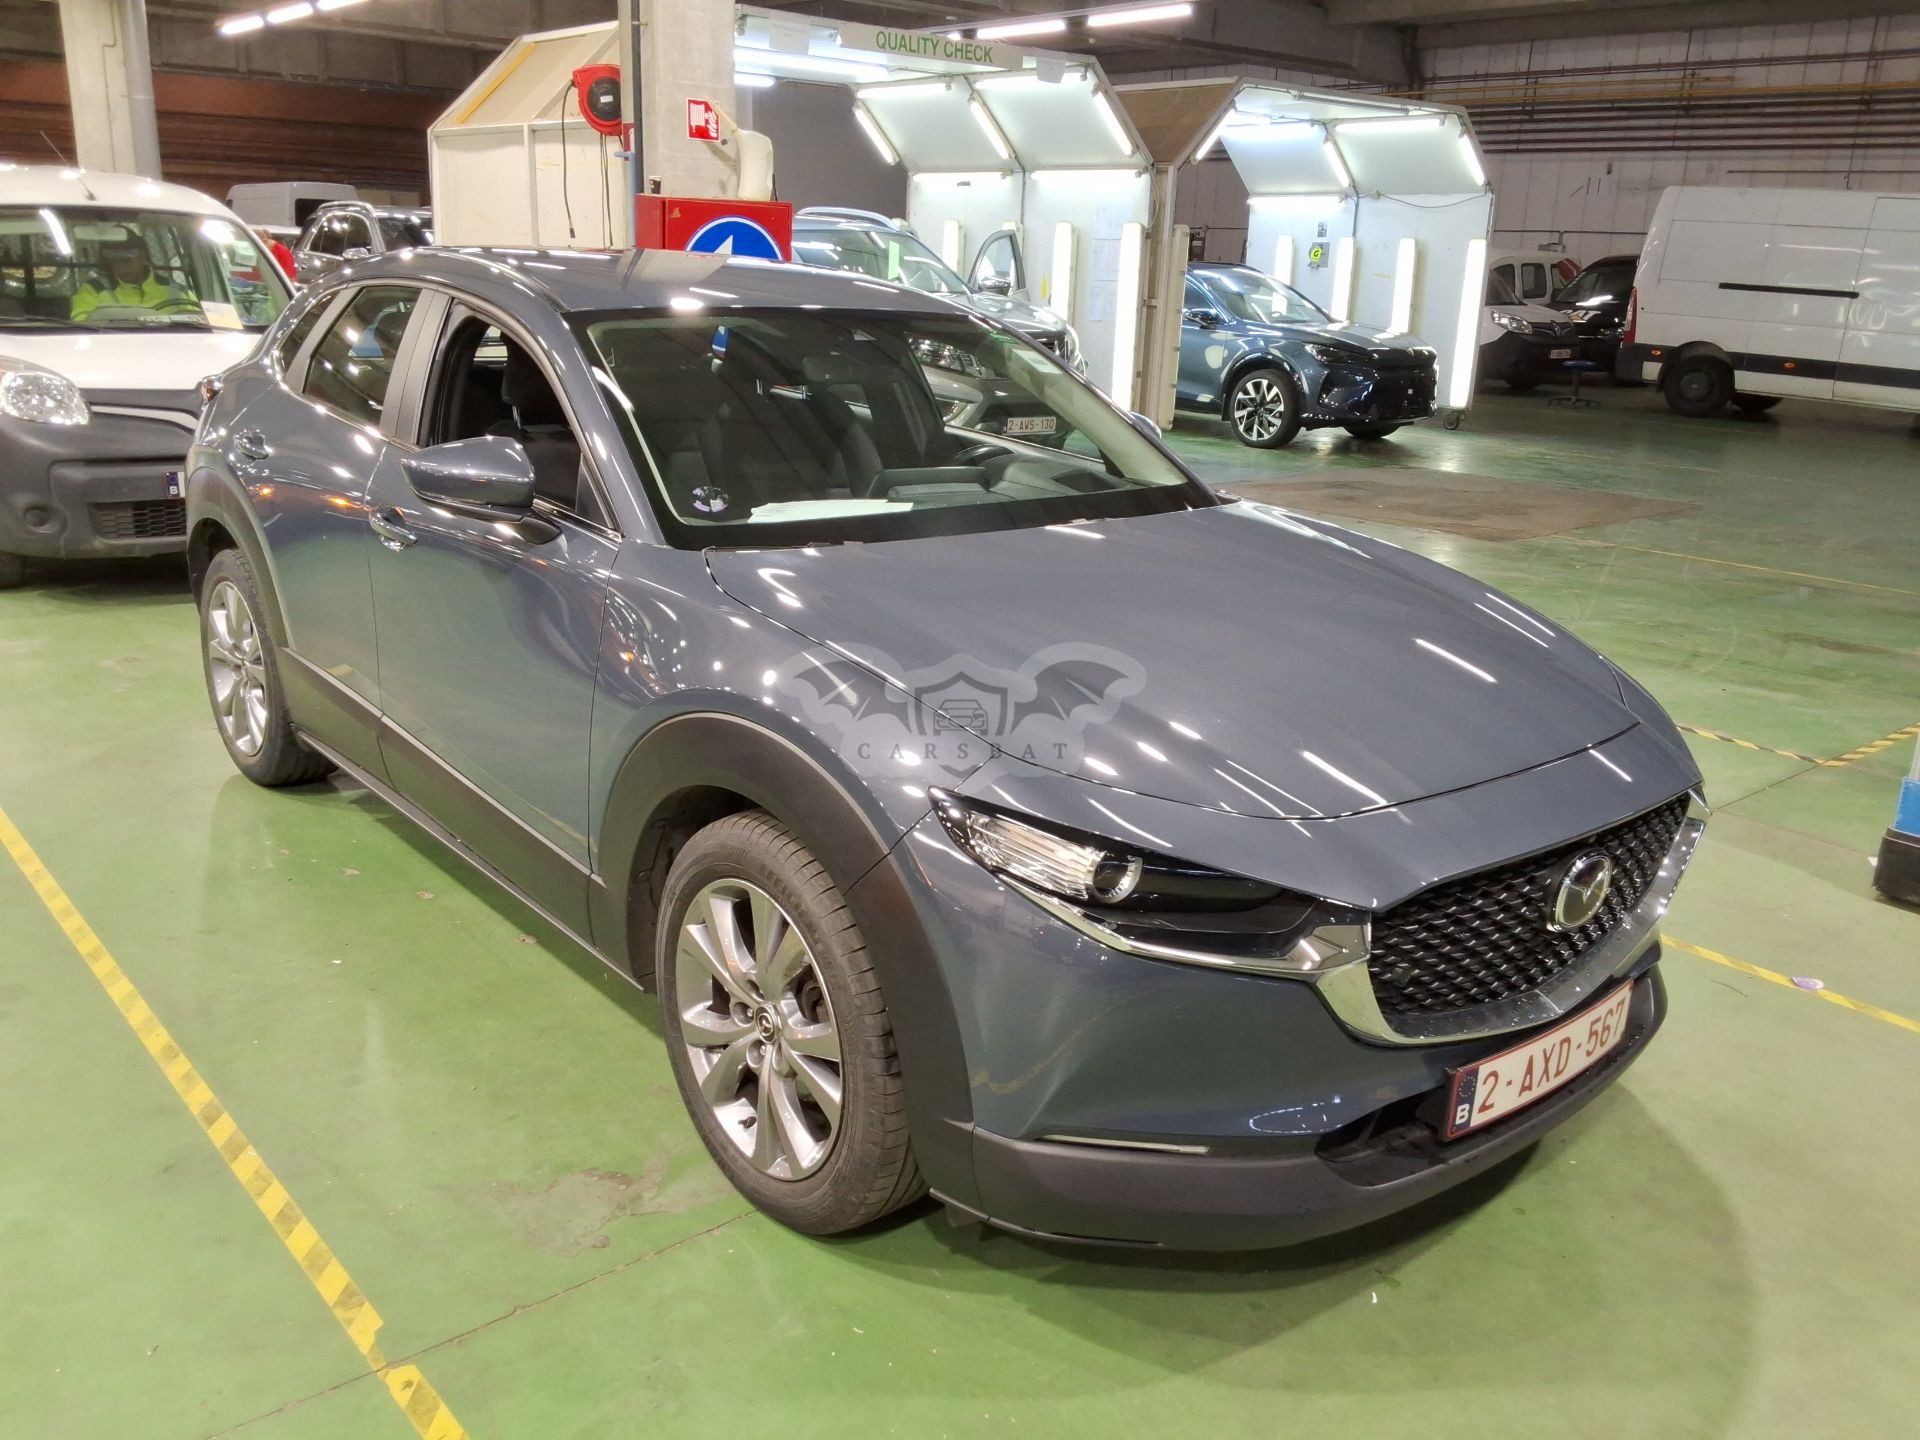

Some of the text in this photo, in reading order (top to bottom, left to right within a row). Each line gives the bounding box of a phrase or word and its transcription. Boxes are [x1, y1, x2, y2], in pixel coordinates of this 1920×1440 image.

[876, 31, 993, 63] QUALITY CHECK
[169, 485, 178, 495] B
[1455, 997, 1626, 1125] B 2-AXD-567
